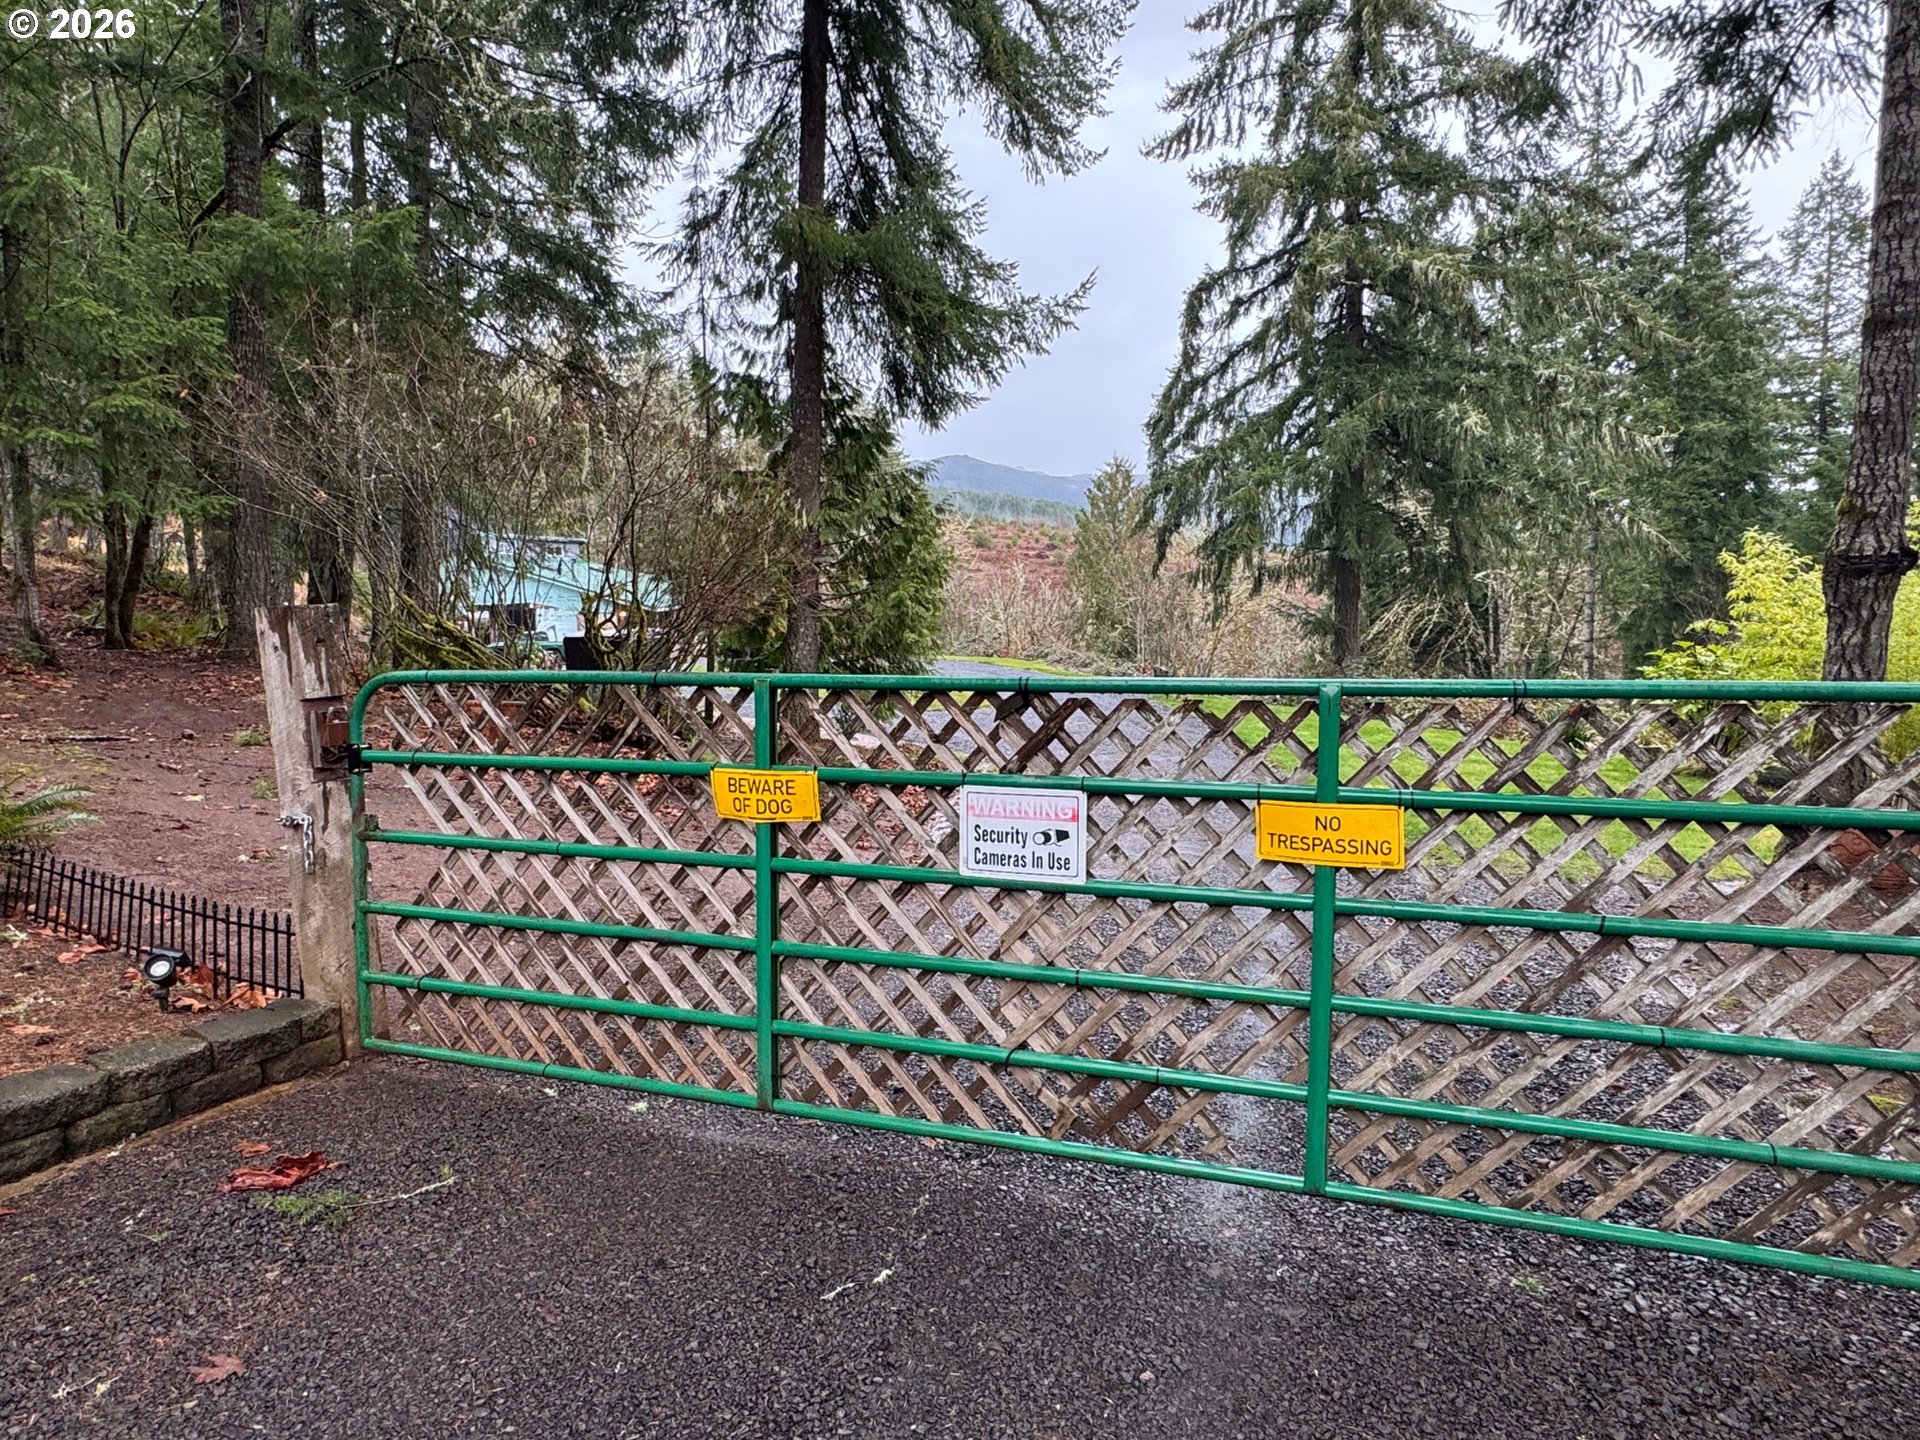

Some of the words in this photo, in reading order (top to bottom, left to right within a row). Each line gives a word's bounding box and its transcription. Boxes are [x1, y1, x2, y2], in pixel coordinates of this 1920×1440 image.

[728, 777, 797, 796] BEWARE
[733, 797, 751, 813] OF
[756, 798, 793, 815] DOG
[972, 797, 1074, 820] WARNING
[1314, 815, 1341, 832] NO
[974, 824, 1028, 849] Security
[1267, 832, 1393, 856] TRESPASSING
[974, 847, 1027, 868] Cameras
[1032, 851, 1043, 869] In
[1048, 852, 1071, 871] Use
